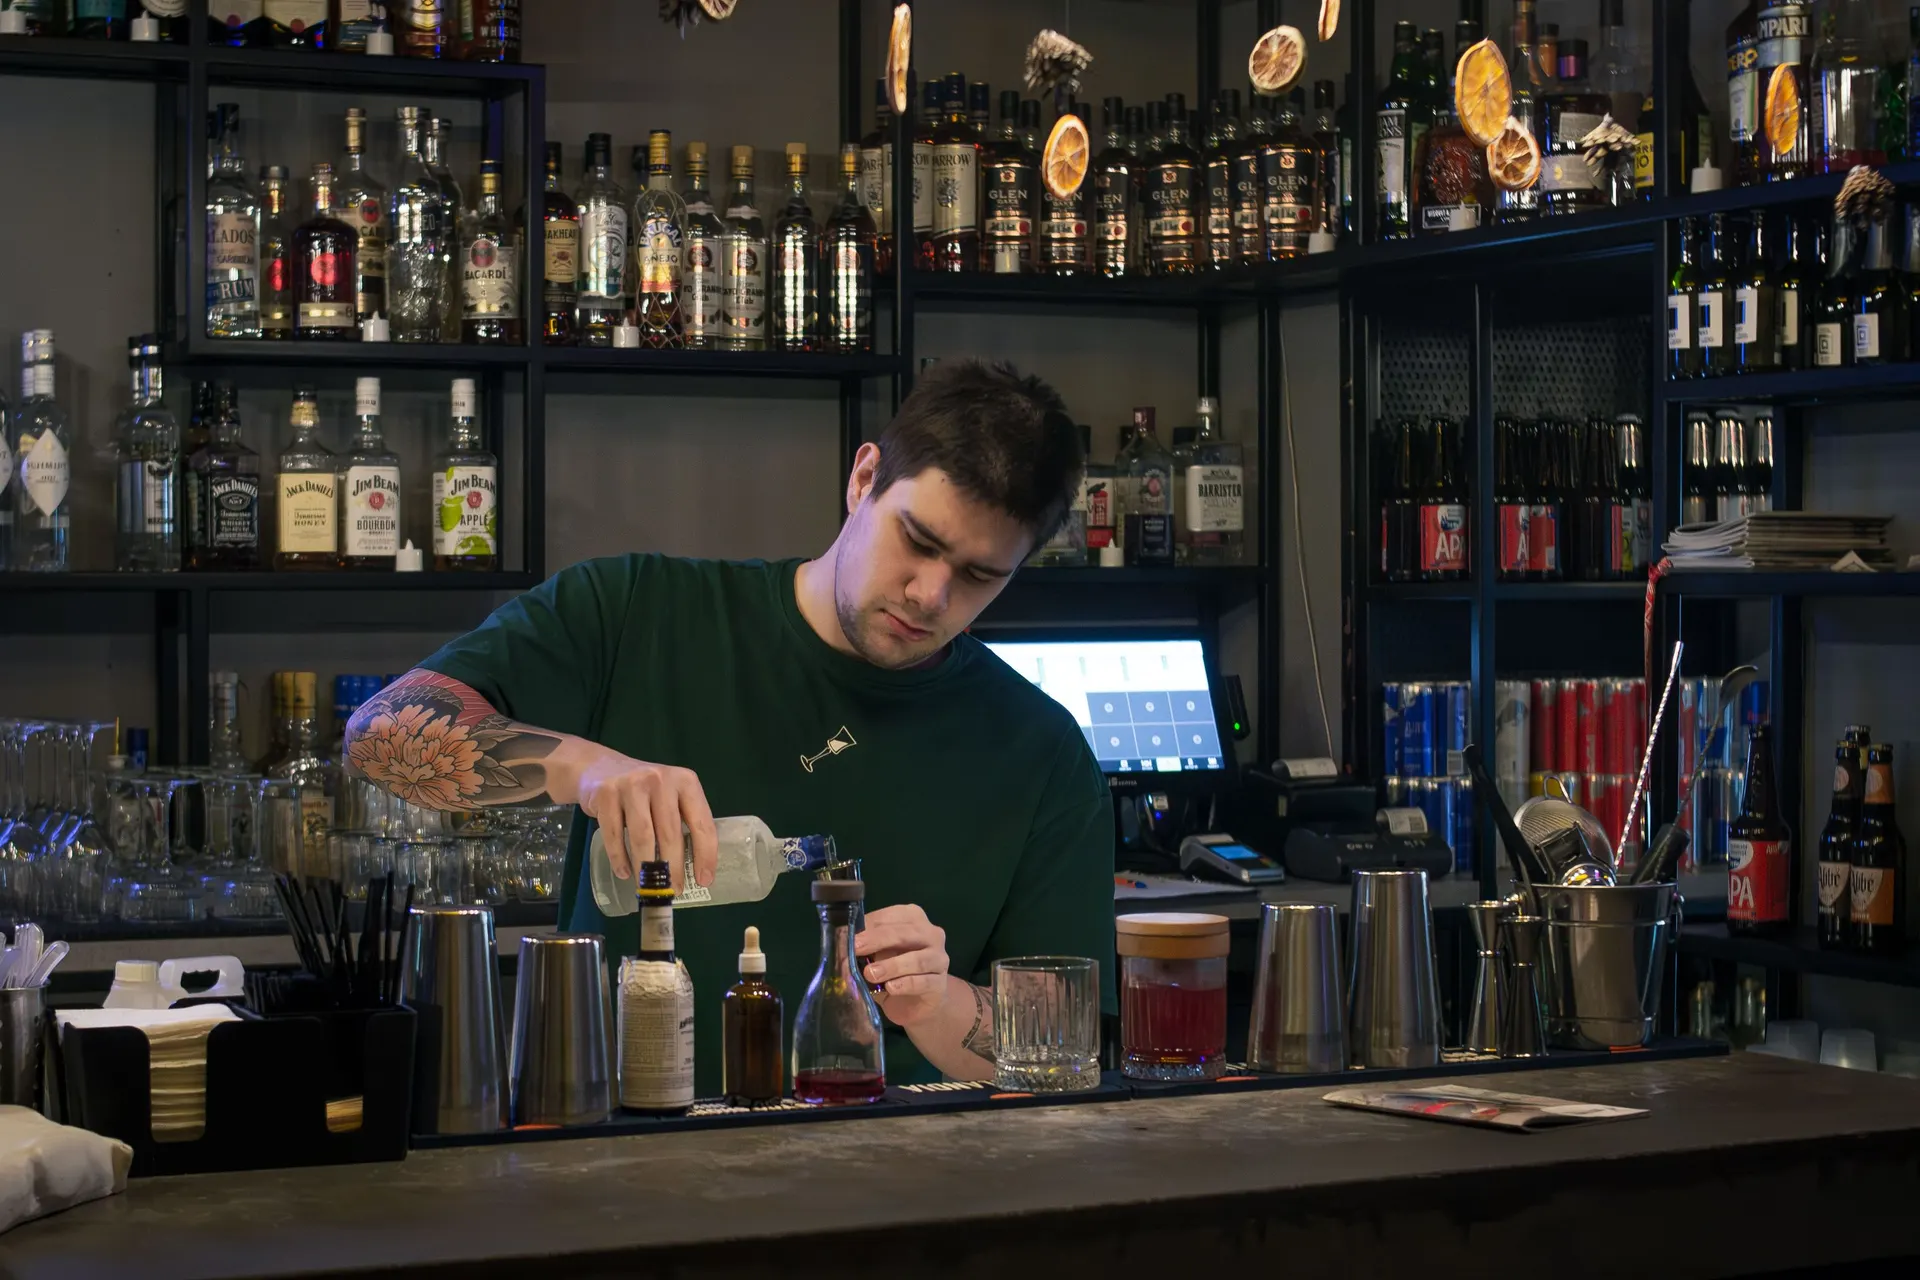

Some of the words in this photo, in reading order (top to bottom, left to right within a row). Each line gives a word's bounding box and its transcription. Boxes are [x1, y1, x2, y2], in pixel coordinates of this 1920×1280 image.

[1268, 176, 1308, 186] GLEN
[988, 189, 1028, 200] GLEN
[1152, 189, 1189, 201] GLEN
[220, 279, 254, 299] RUM
[286, 484, 305, 499] JACK
[352, 479, 372, 497] JIM
[373, 474, 400, 497] BEAM
[450, 479, 470, 496] JIM
[1198, 483, 1242, 497] BARRISTER
[357, 519, 396, 531] BOURBON
[460, 514, 489, 526] APPLE
